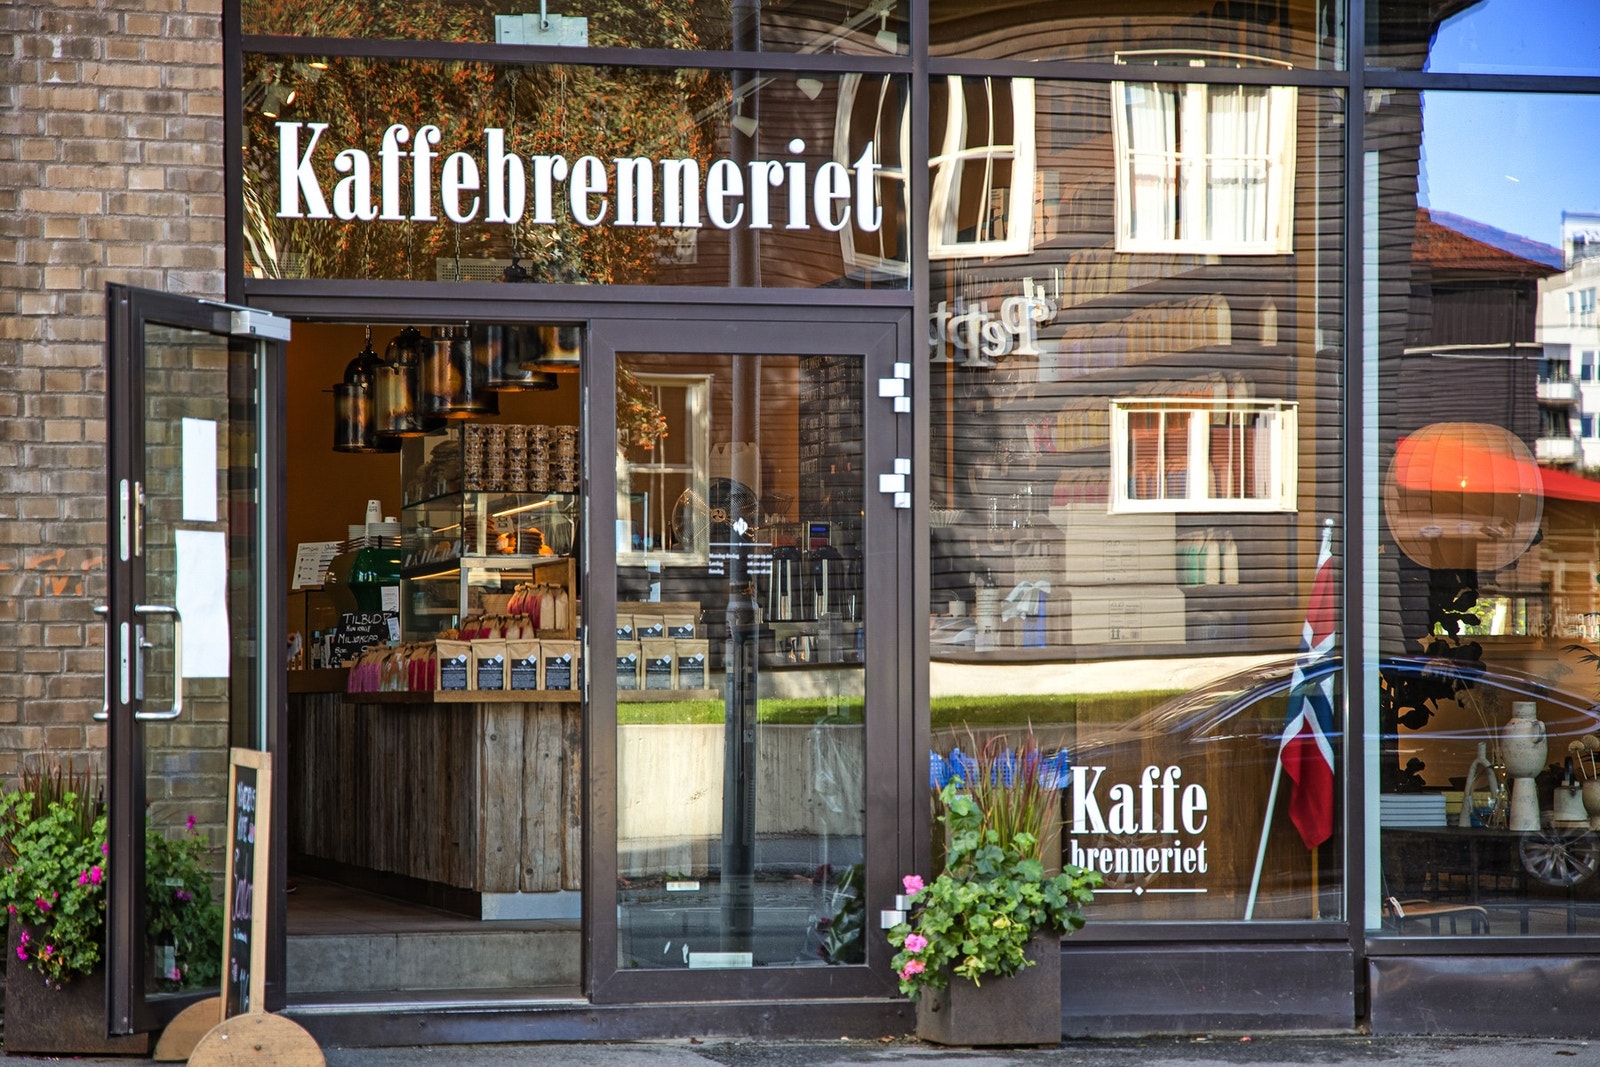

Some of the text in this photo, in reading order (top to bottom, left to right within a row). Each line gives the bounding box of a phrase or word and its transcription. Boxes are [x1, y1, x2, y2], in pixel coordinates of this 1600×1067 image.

[275, 120, 882, 233] Kaffebrenneriet
[1070, 765, 1208, 835] Kaffe
[1070, 839, 1208, 874] brenneriet
